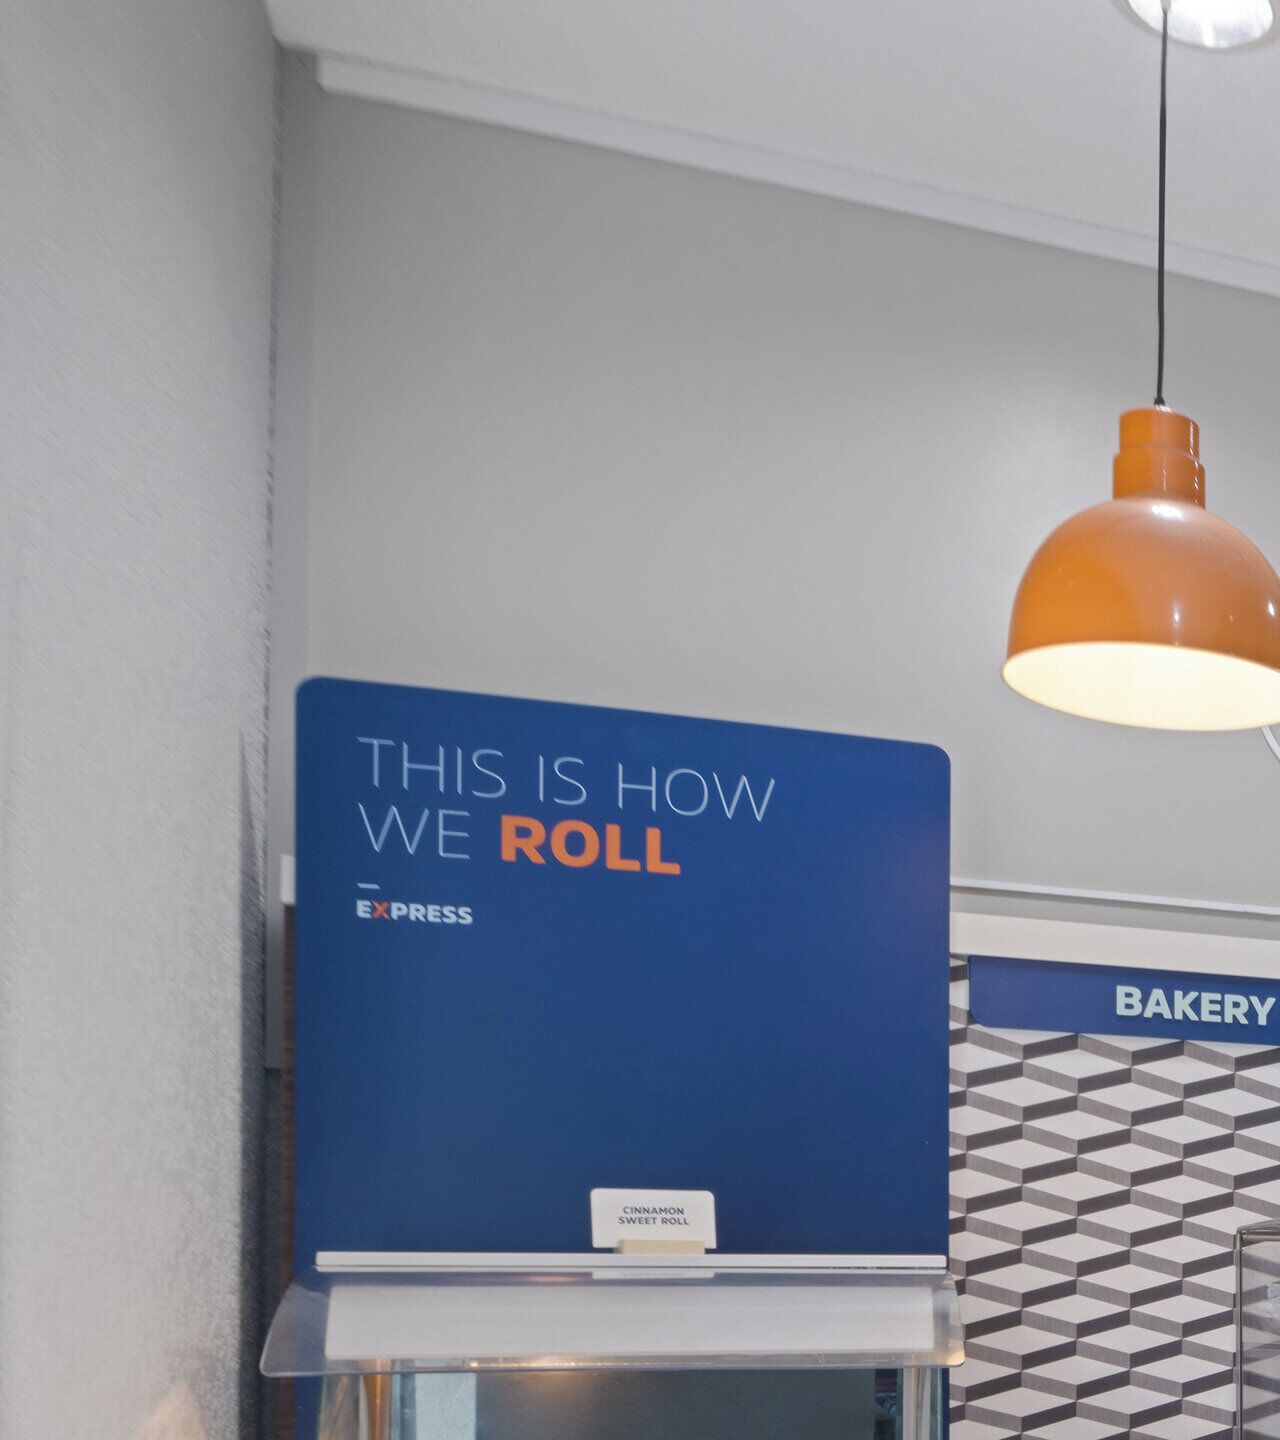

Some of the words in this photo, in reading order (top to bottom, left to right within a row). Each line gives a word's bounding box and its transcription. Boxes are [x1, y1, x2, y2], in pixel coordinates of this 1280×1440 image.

[356, 736, 507, 799] THIS
[538, 753, 588, 806] IS
[617, 760, 776, 823] HOW
[357, 801, 471, 860] WE
[500, 813, 682, 876] ROLL
[355, 899, 474, 925] EXPRESS
[1115, 984, 1278, 1027] BAKERY
[618, 1215, 658, 1225] SWEET
[660, 1216, 690, 1226] ROLL
[623, 1205, 685, 1216] CINNAMON
